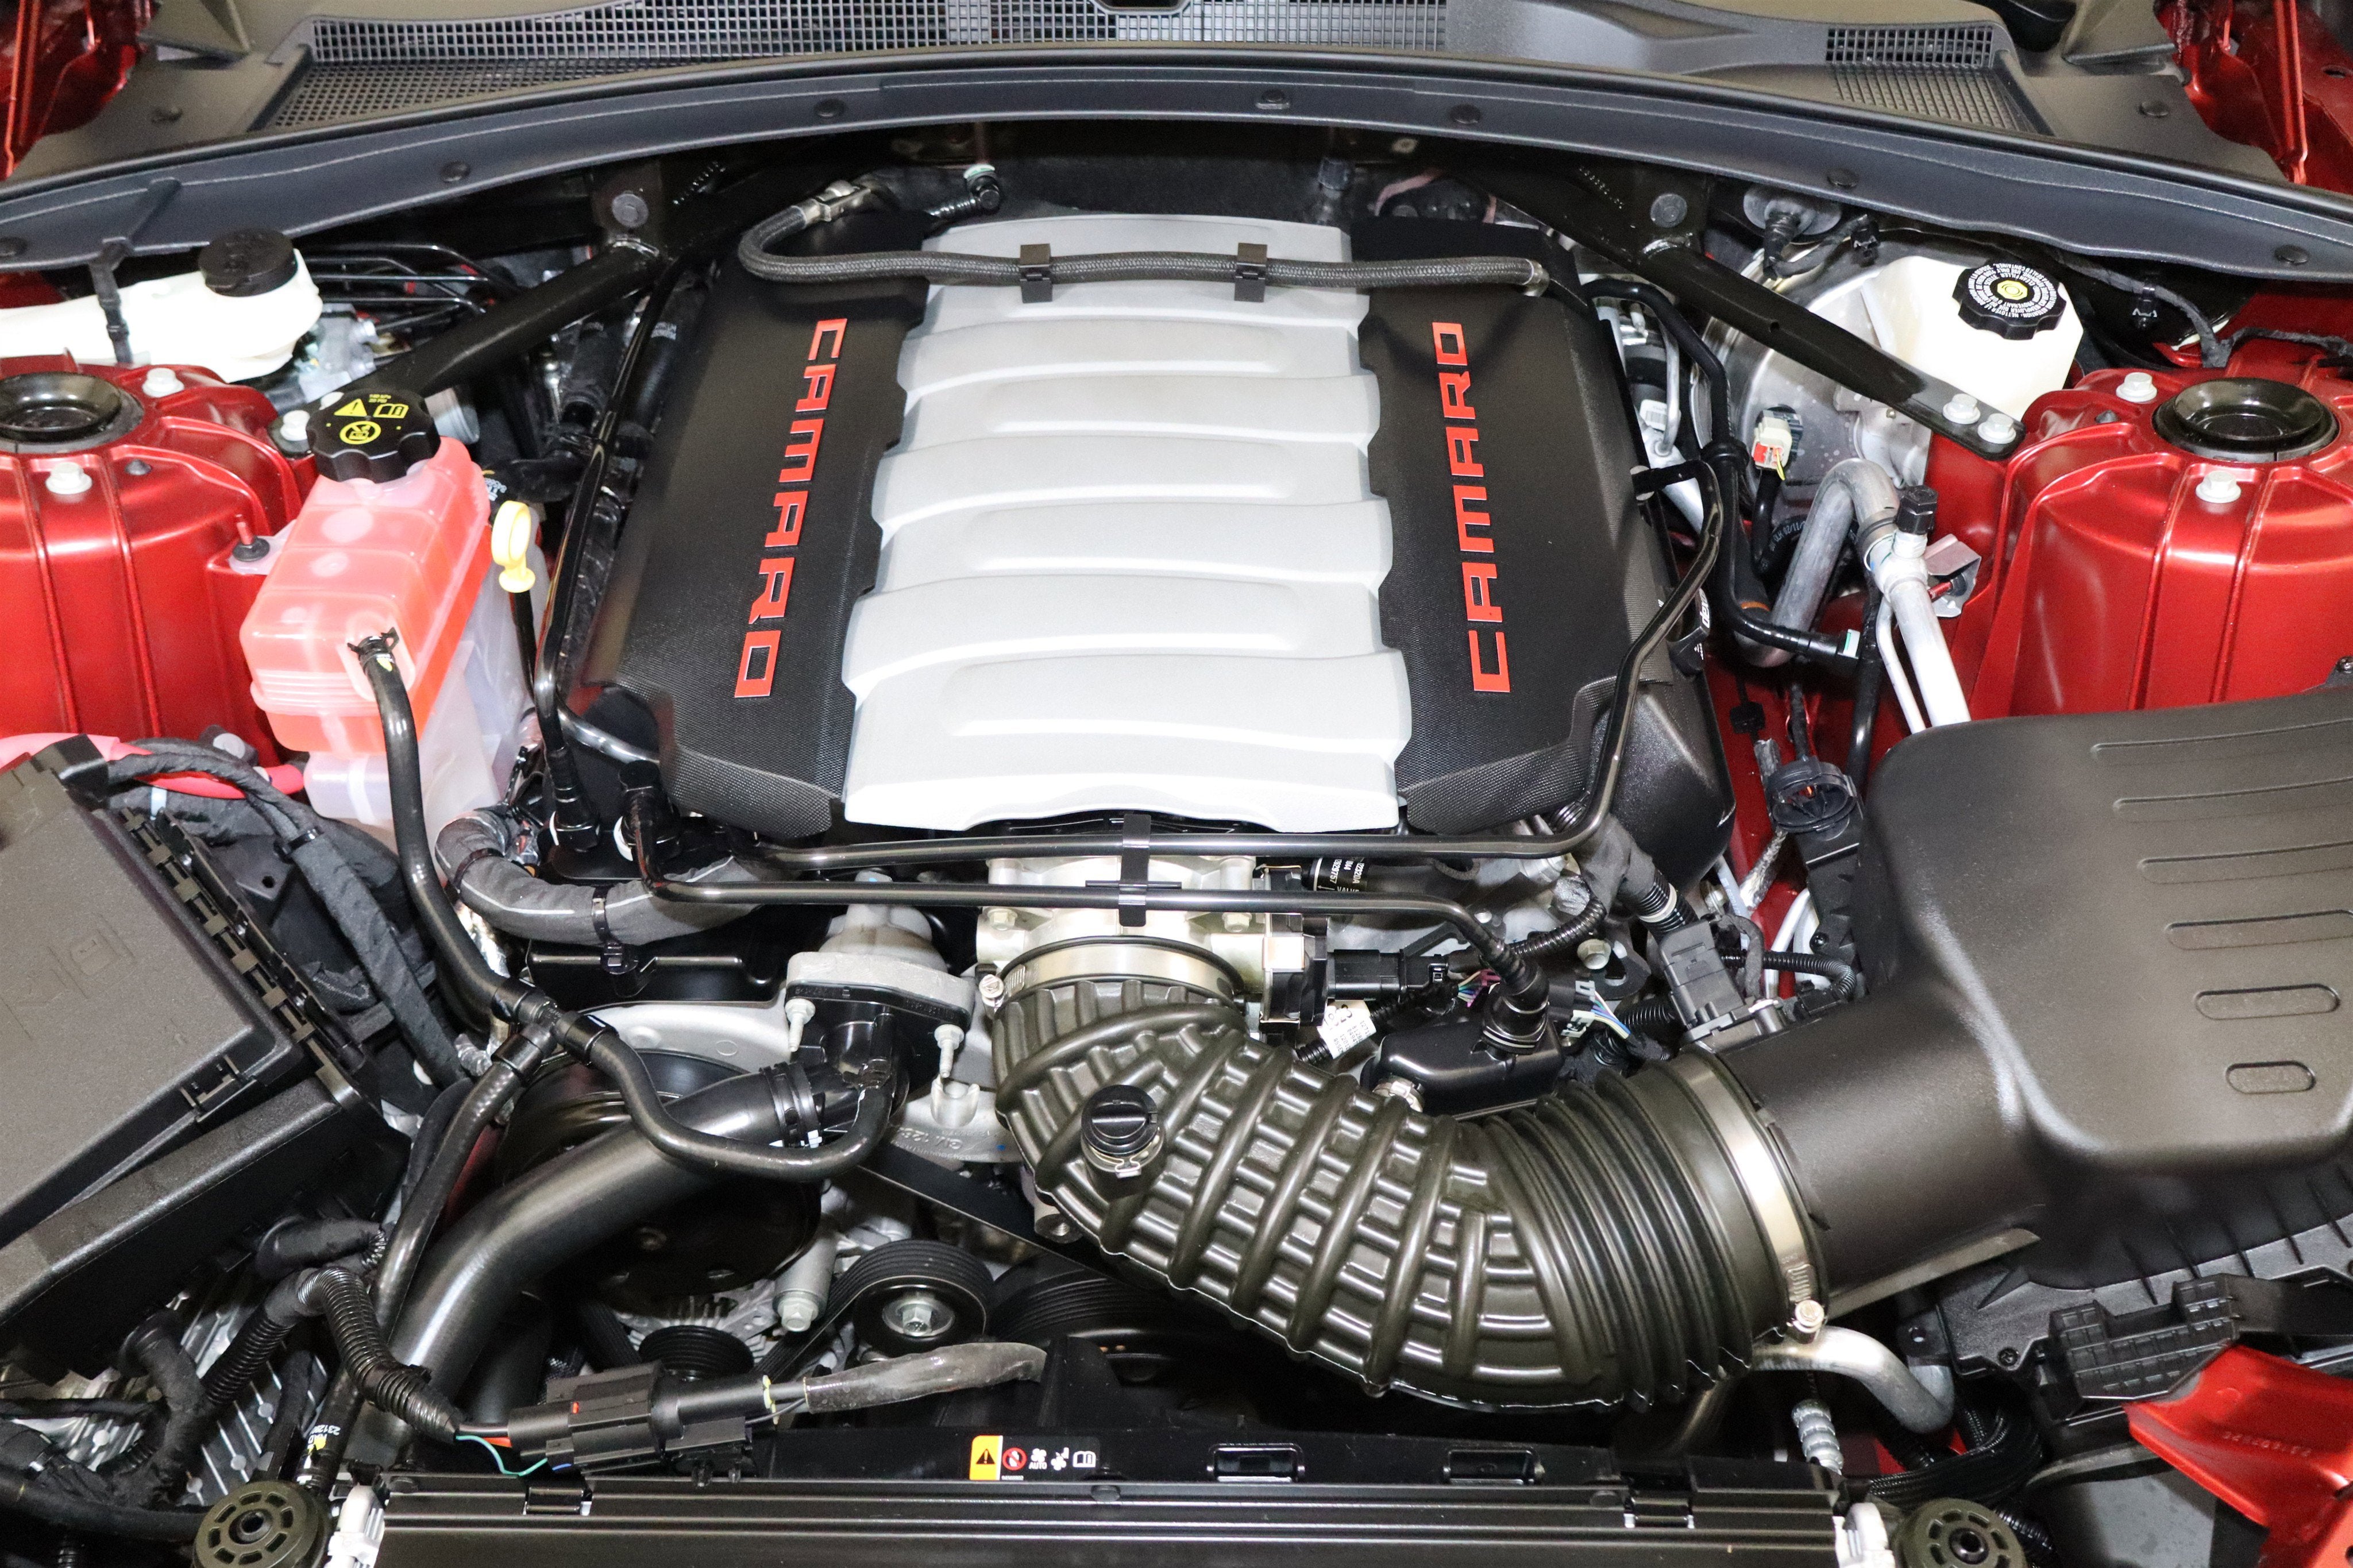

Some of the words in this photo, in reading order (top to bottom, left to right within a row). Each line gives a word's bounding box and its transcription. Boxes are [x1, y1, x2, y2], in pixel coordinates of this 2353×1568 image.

[1991, 307, 2019, 318] NETTOYER
[734, 318, 848, 699] CAMARO
[1431, 322, 1511, 693] CAMARO
